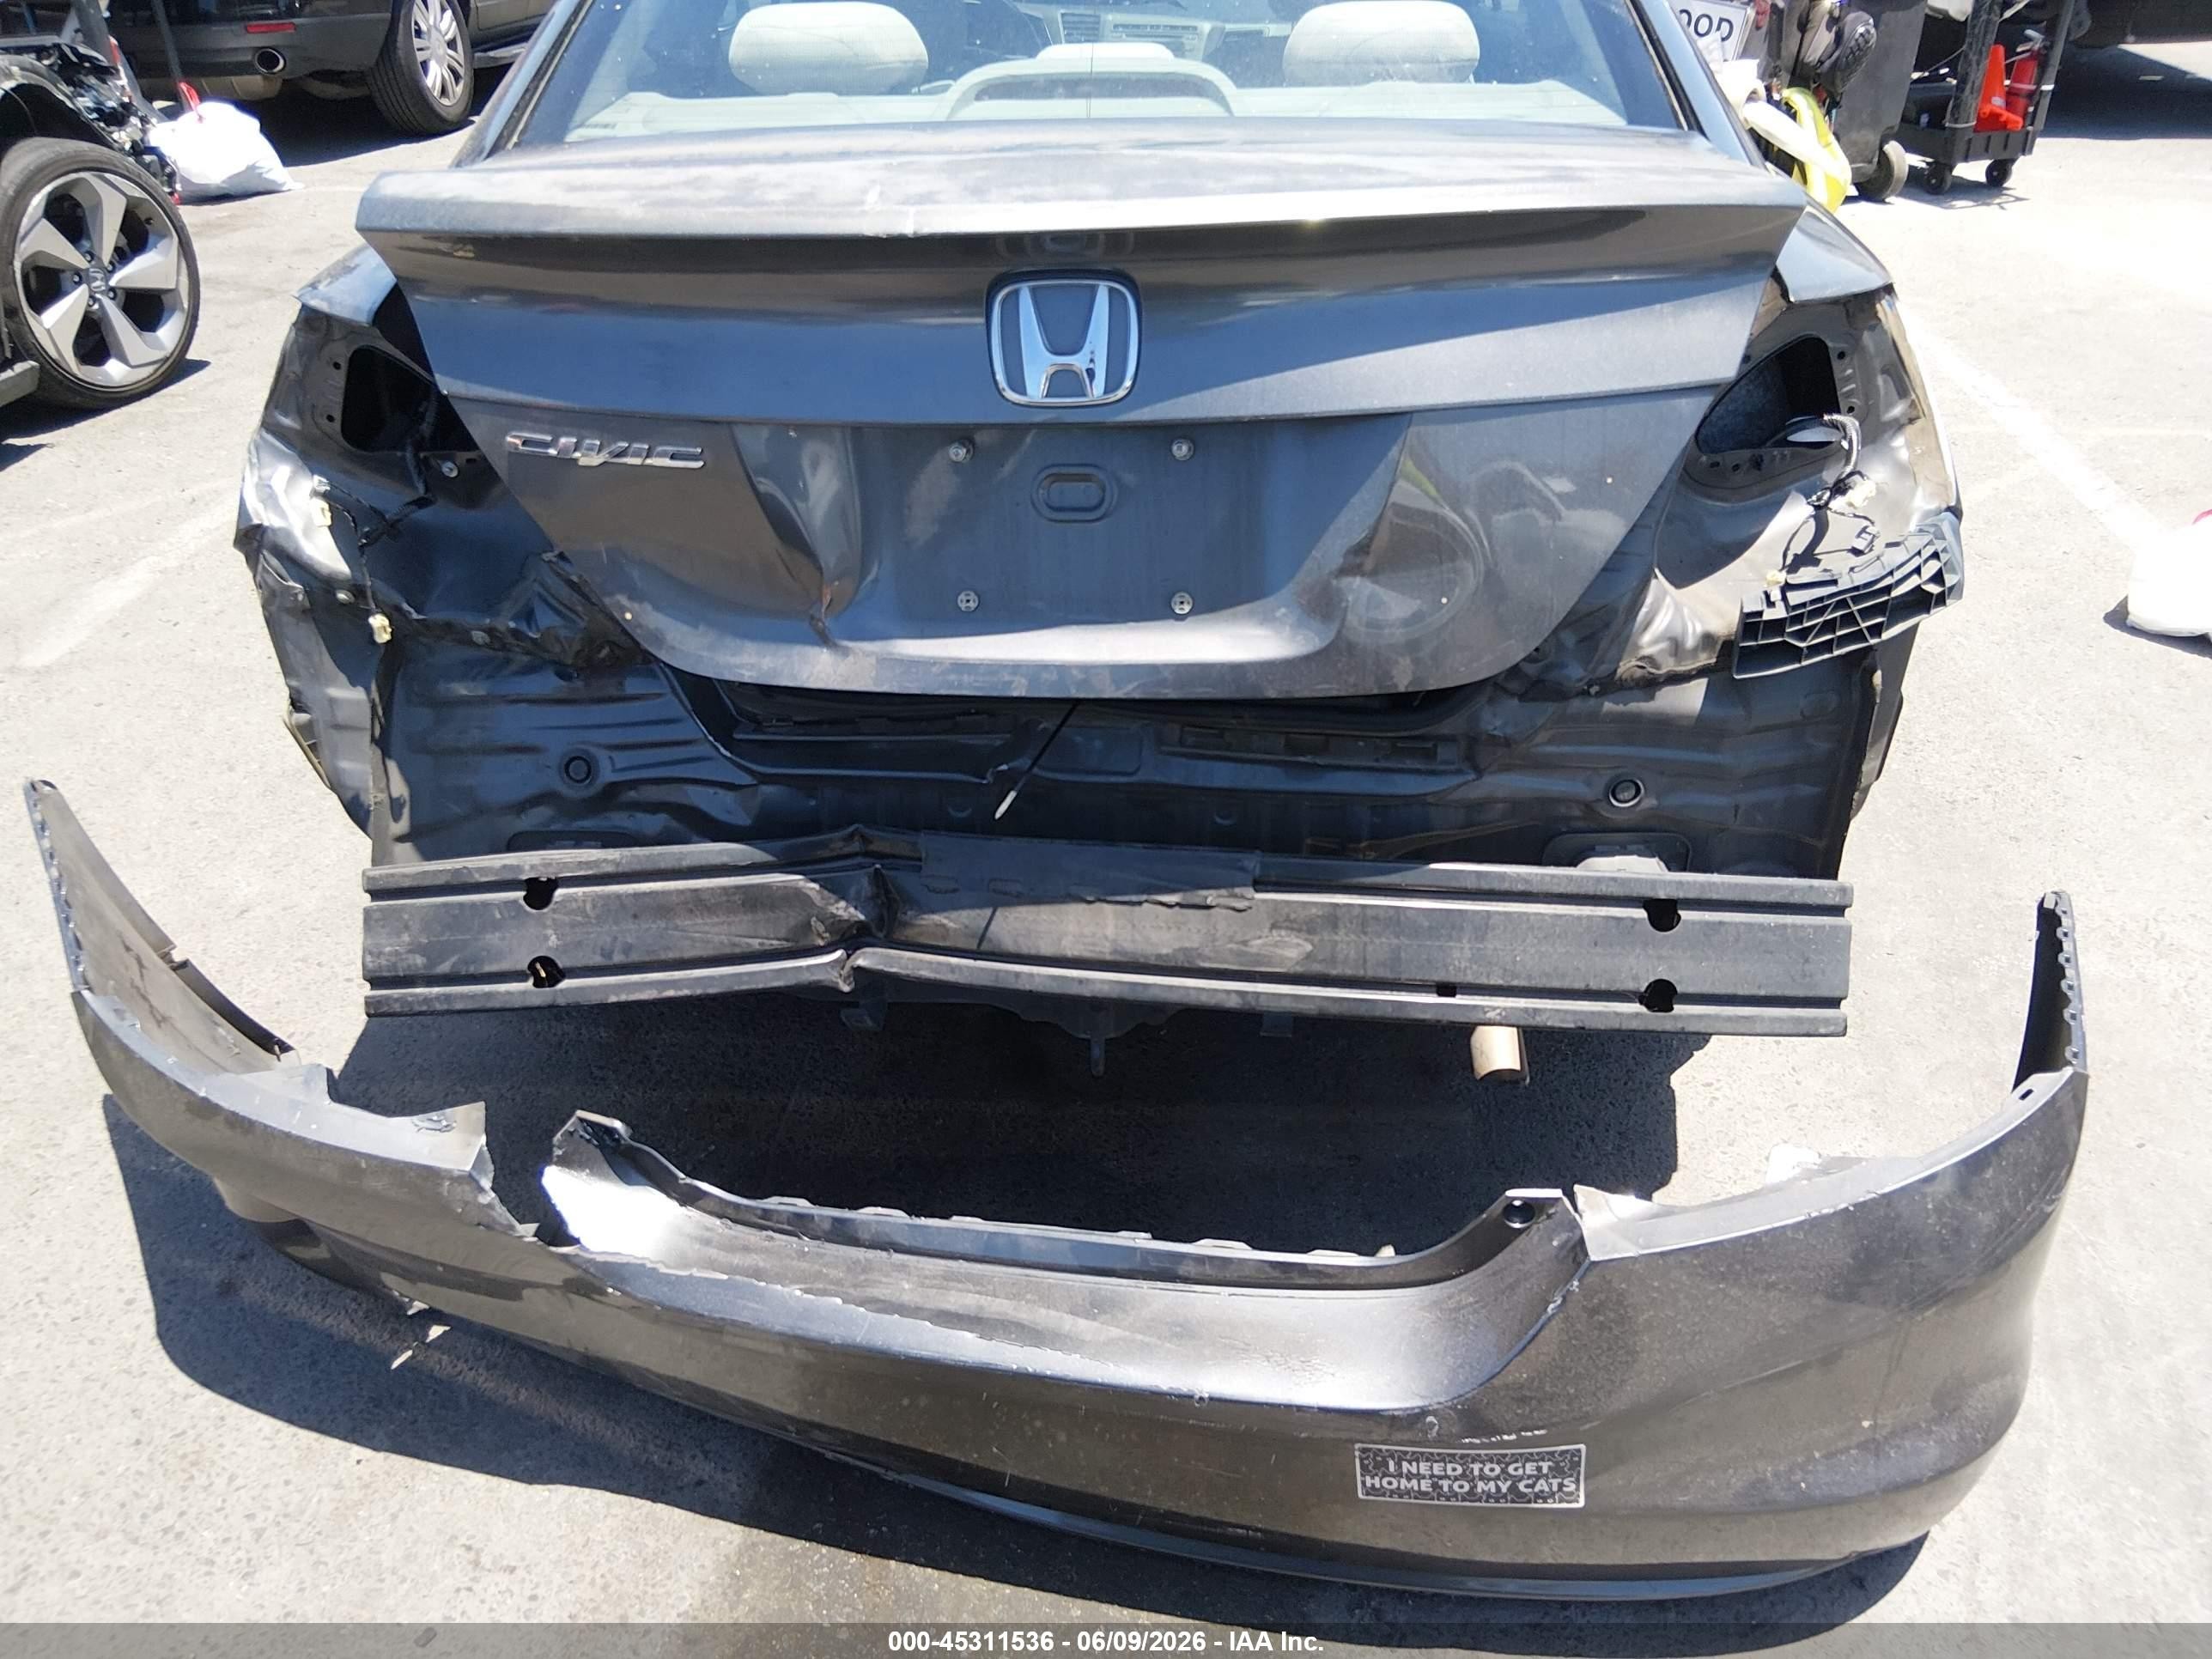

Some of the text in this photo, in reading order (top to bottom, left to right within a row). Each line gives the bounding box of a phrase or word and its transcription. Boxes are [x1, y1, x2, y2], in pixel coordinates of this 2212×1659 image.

[506, 431, 705, 469] CIVIC
[1388, 1460, 1553, 1478] I NEED TO GET
[1364, 1476, 1577, 1493] HOME TO MY CATS
